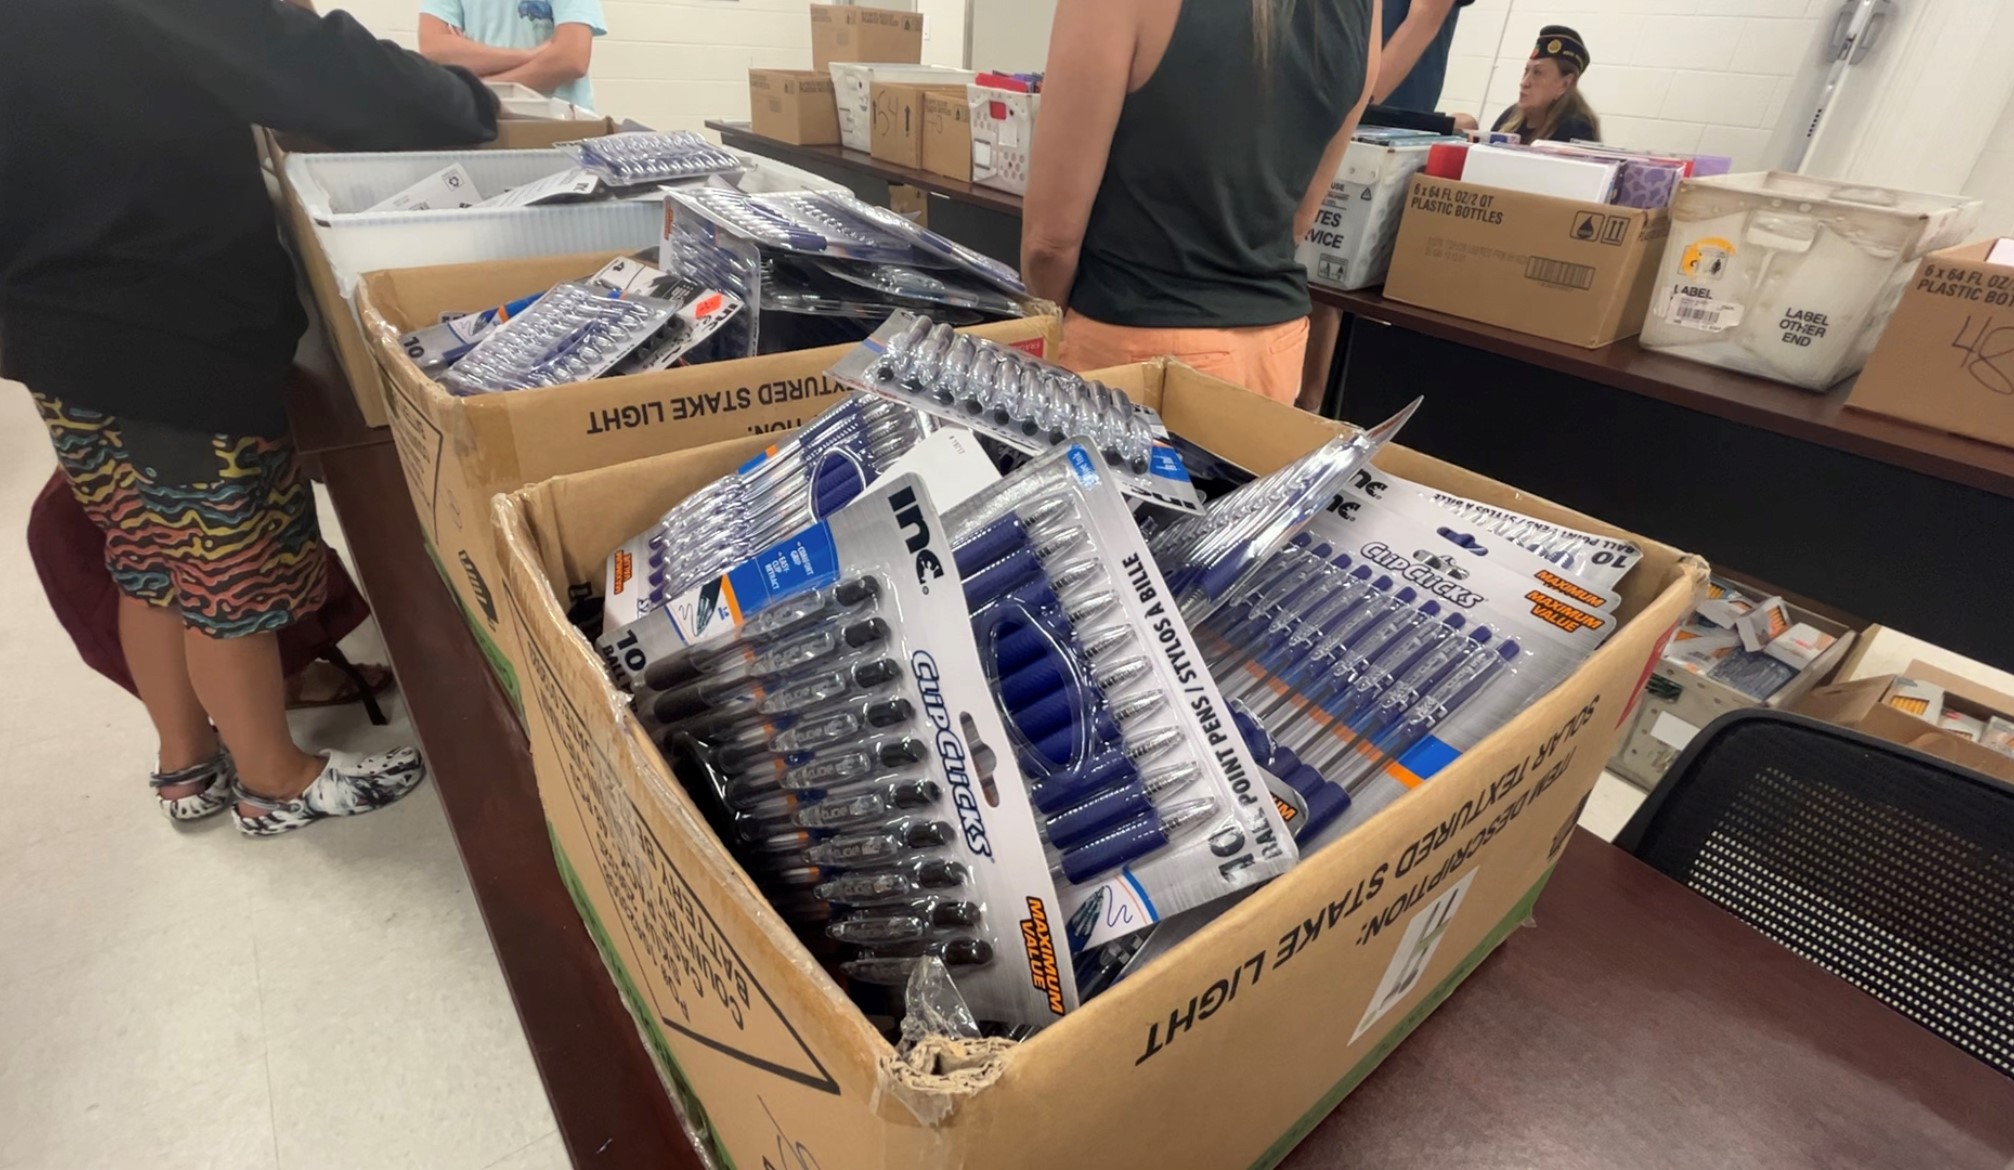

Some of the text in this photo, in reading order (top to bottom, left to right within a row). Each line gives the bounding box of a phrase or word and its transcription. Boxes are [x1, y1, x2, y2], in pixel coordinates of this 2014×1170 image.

[1411, 197, 1503, 225] PLASTIC BOTTLES
[1414, 183, 1421, 195] 6
[1428, 185, 1441, 199] 64
[1442, 188, 1452, 202] FL
[1480, 195, 1494, 207] QT
[1315, 209, 1342, 227] TES
[1674, 284, 1713, 299] LABEL
[1917, 279, 2014, 307] PLASTIC BOT
[1925, 264, 1935, 277] 6
[1947, 268, 1965, 282] 64
[1967, 271, 1982, 286] FL
[1779, 319, 1827, 338] OTHER
[1785, 308, 1829, 326] LABEL
[404, 337, 424, 358] 10
[1781, 332, 1811, 347] END
[587, 375, 855, 435] XTURED STAKE LIGHT
[765, 563, 780, 590] RETRACT
[771, 559, 782, 574] CLIP
[798, 545, 814, 576] COMFORT
[1122, 552, 1157, 603] BILLE
[1591, 551, 1627, 569] 10
[1534, 569, 1607, 608] MAXIMUM
[1524, 590, 1605, 631] MAXIMUM
[1531, 603, 1584, 633] VALUE
[602, 645, 627, 682] BALL
[617, 629, 646, 672] 10
[1153, 618, 1197, 684] STYLOS
[1191, 695, 1228, 746] PENS
[1531, 694, 1600, 772] SOLAR
[1215, 748, 1257, 806] POINT
[1528, 745, 1577, 805] ITEM
[1394, 755, 1530, 879] TEXTURED
[1356, 792, 1530, 946] DESCRIPTION:
[661, 862, 751, 1010] BATTERY
[1272, 862, 1388, 971] STAKE
[657, 885, 744, 1031] COUNTRY
[658, 914, 704, 998] CASE
[1020, 919, 1046, 992] VALUE
[1026, 895, 1066, 1016] MAXIMUM
[1135, 950, 1267, 1067] LIGHT
